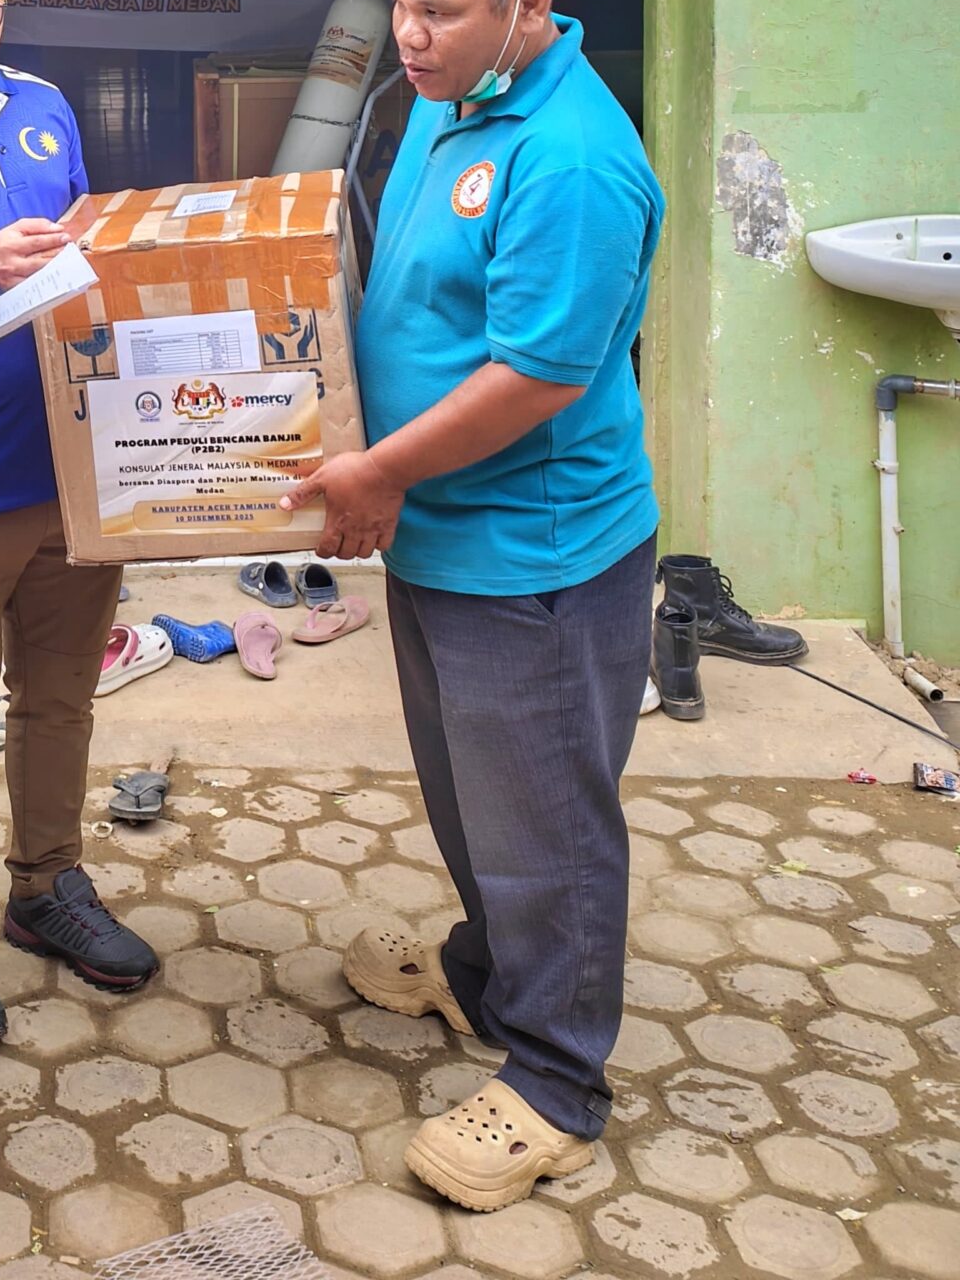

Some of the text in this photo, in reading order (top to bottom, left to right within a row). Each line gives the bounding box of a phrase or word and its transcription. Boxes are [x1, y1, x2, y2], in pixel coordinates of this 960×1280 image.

[245, 394, 293, 406] mercy
[115, 433, 302, 448] PROGRAM PEDULI BENCANA BANJIR
[191, 445, 225, 454] (P2B2)
[119, 459, 299, 474] KONSULAT JENERAL MALAYSIA DI MEDAN
[119, 479, 155, 487] bersama
[157, 477, 195, 487] Diaspora
[198, 476, 214, 484] dan
[216, 476, 248, 485] Pelajar
[250, 475, 290, 484] Malaysia
[195, 487, 225, 495] Medan
[152, 502, 277, 513] KABUPATEN ACEH TAMIANG
[175, 515, 185, 523] 10
[187, 514, 232, 523] DISEMBER
